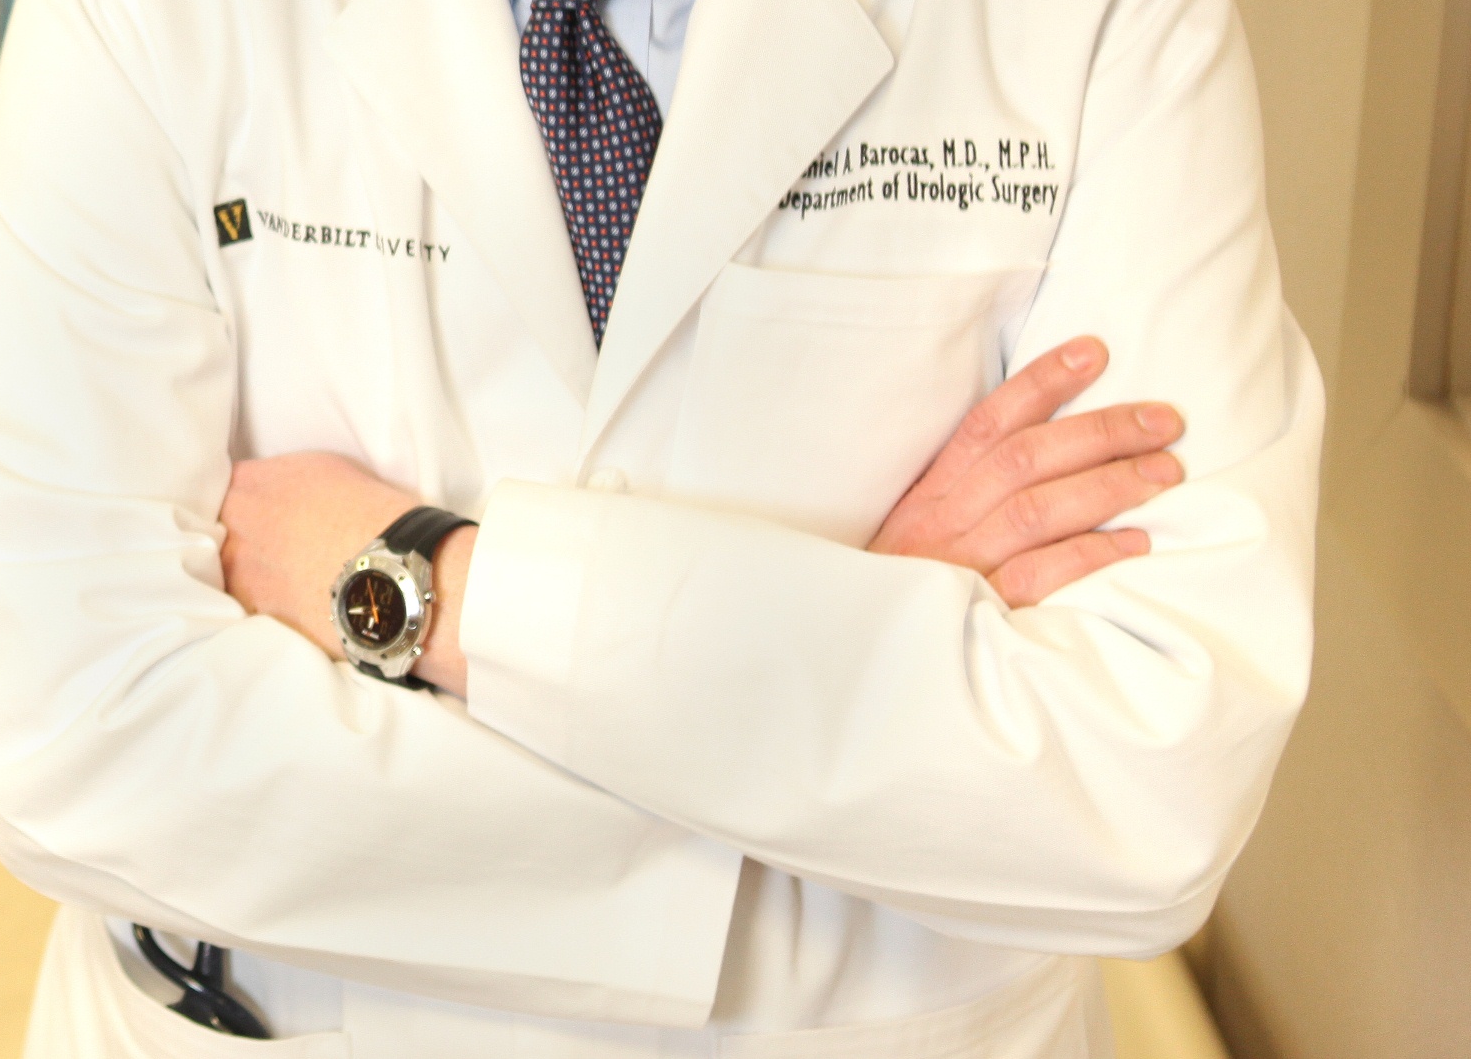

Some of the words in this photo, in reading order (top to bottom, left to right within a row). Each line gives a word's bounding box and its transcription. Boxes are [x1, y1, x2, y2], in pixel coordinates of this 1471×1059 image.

[801, 151, 839, 179] niel
[859, 142, 935, 171] Barocas,
[998, 139, 1057, 170] M.P.H.
[882, 172, 902, 201] of
[906, 172, 986, 210] Urologic
[991, 174, 1060, 215] Surgery
